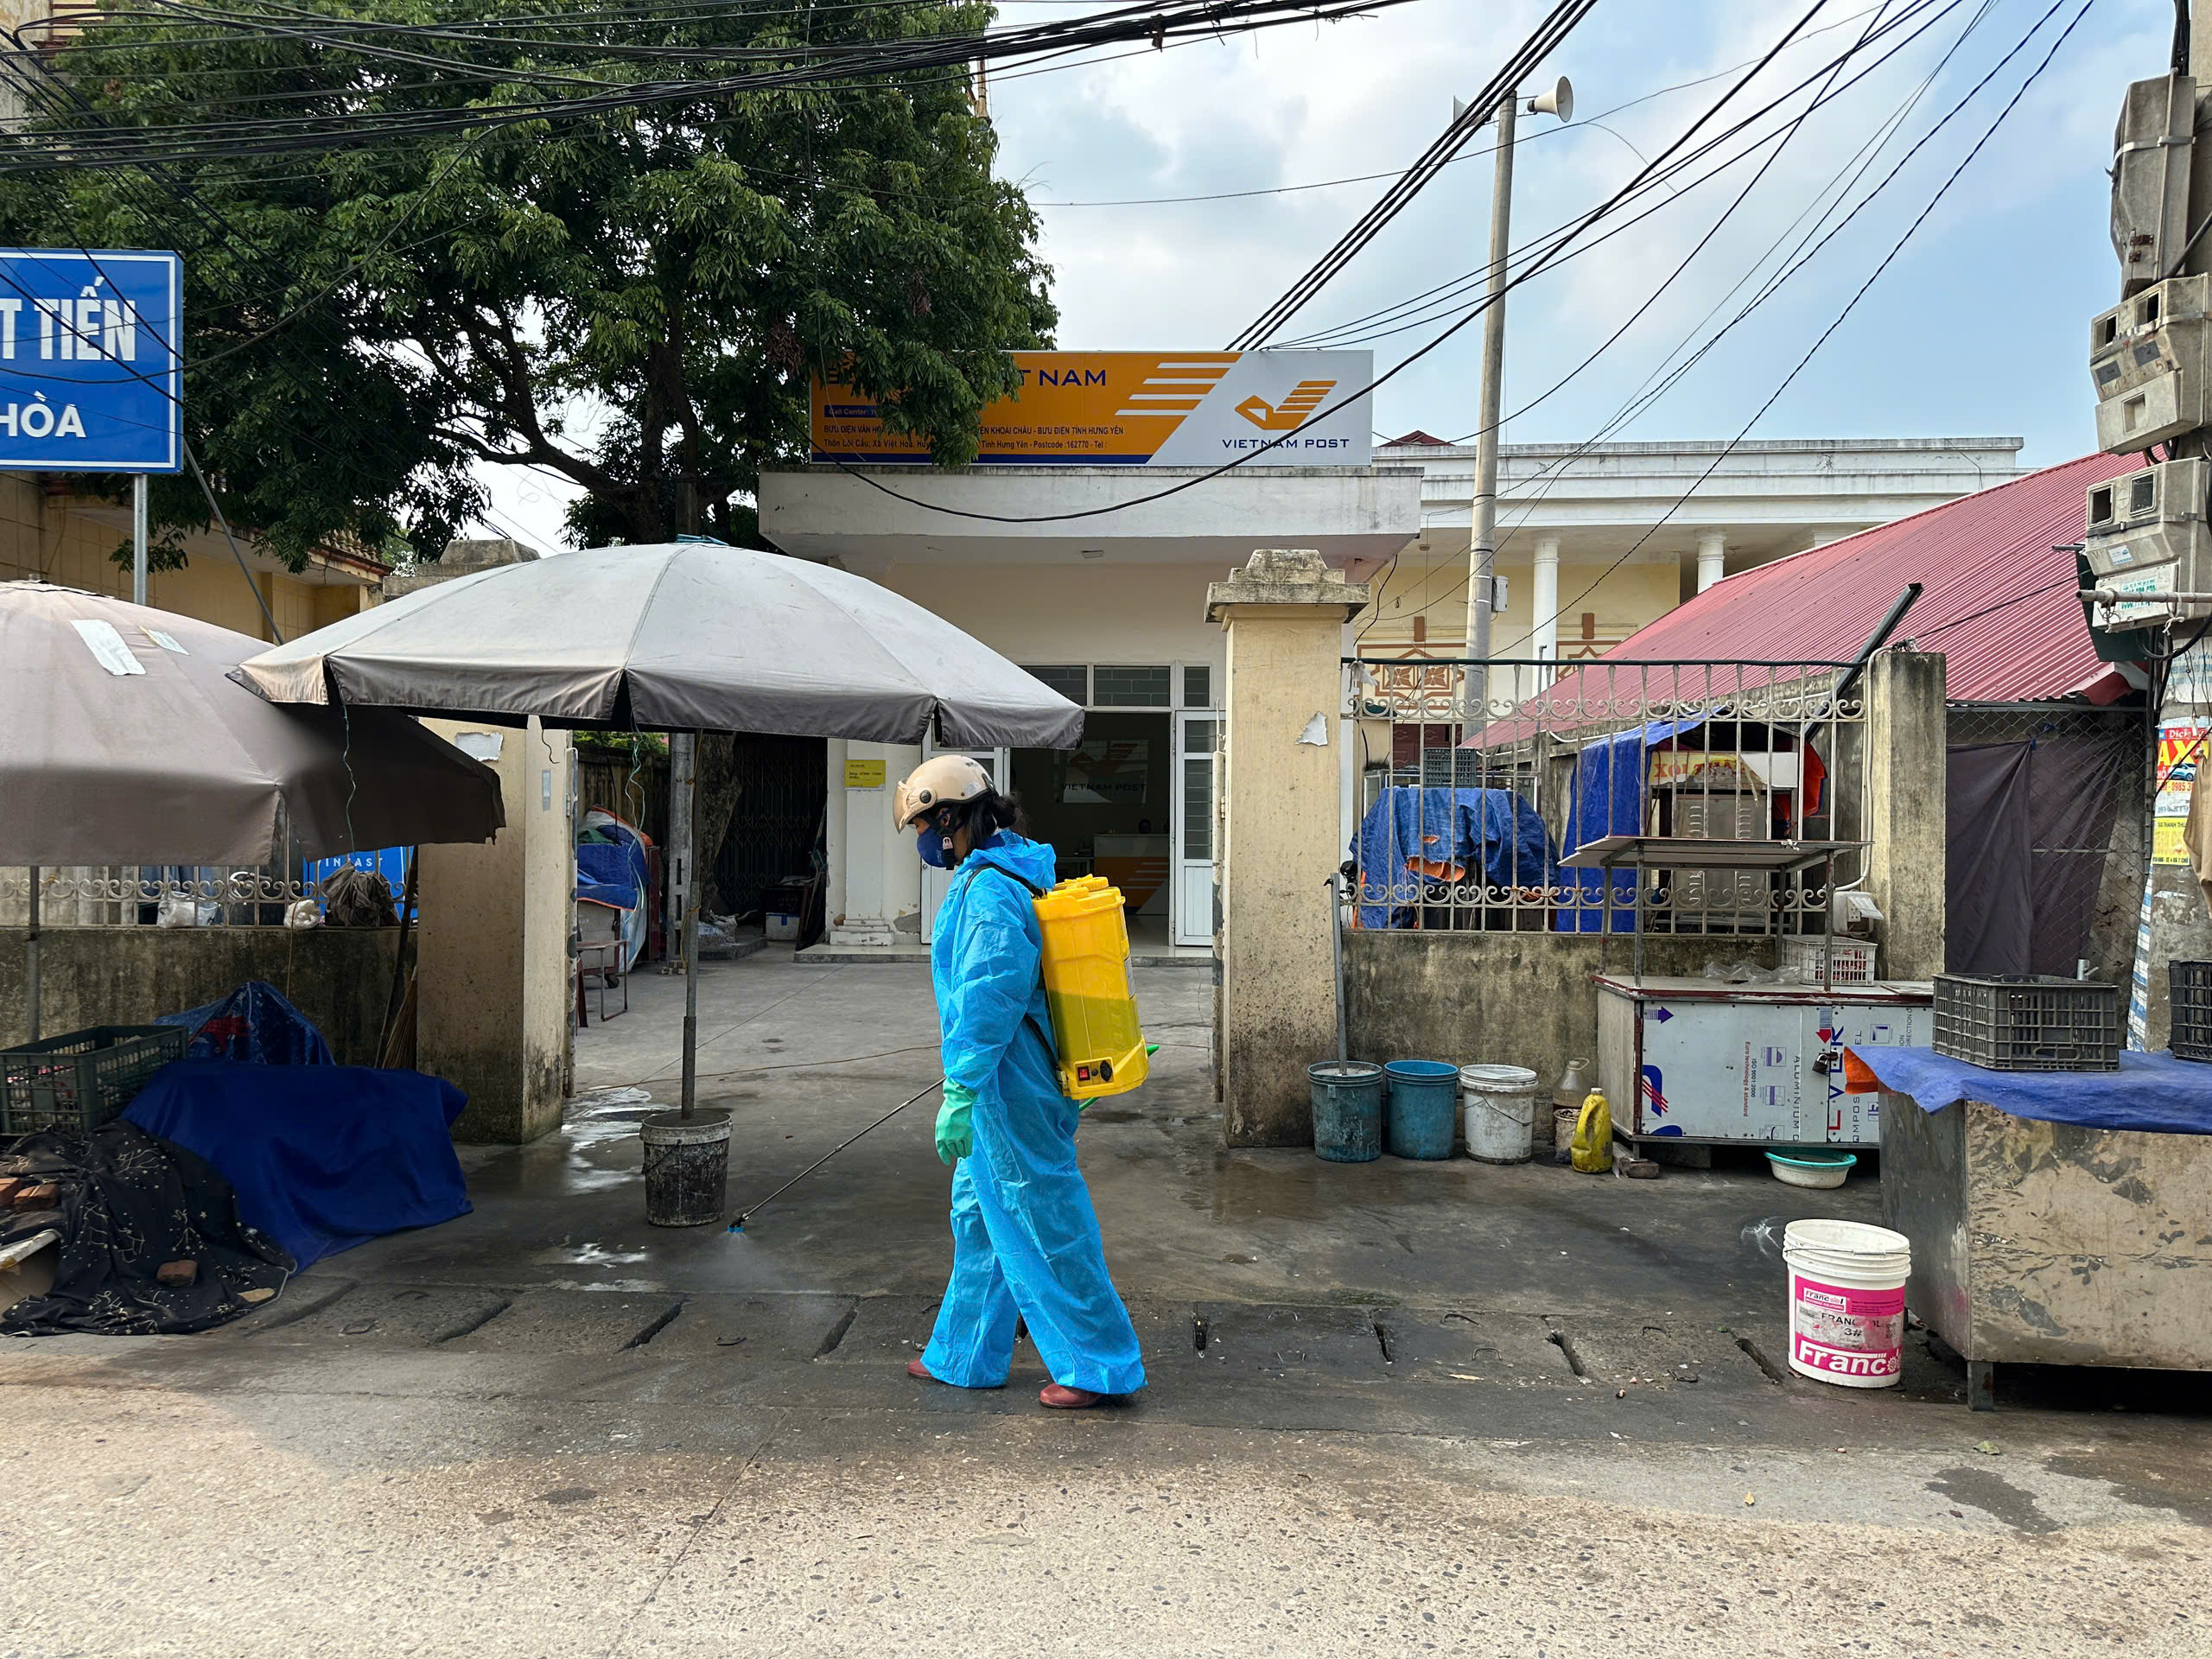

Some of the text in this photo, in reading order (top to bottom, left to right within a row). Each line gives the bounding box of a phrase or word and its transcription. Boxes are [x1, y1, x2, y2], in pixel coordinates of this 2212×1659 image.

[34, 276, 136, 361] TIẾN
[1039, 369, 1106, 386] NAM
[1033, 440, 1063, 448] Postcode
[1222, 439, 1350, 448] VIETNAM POST
